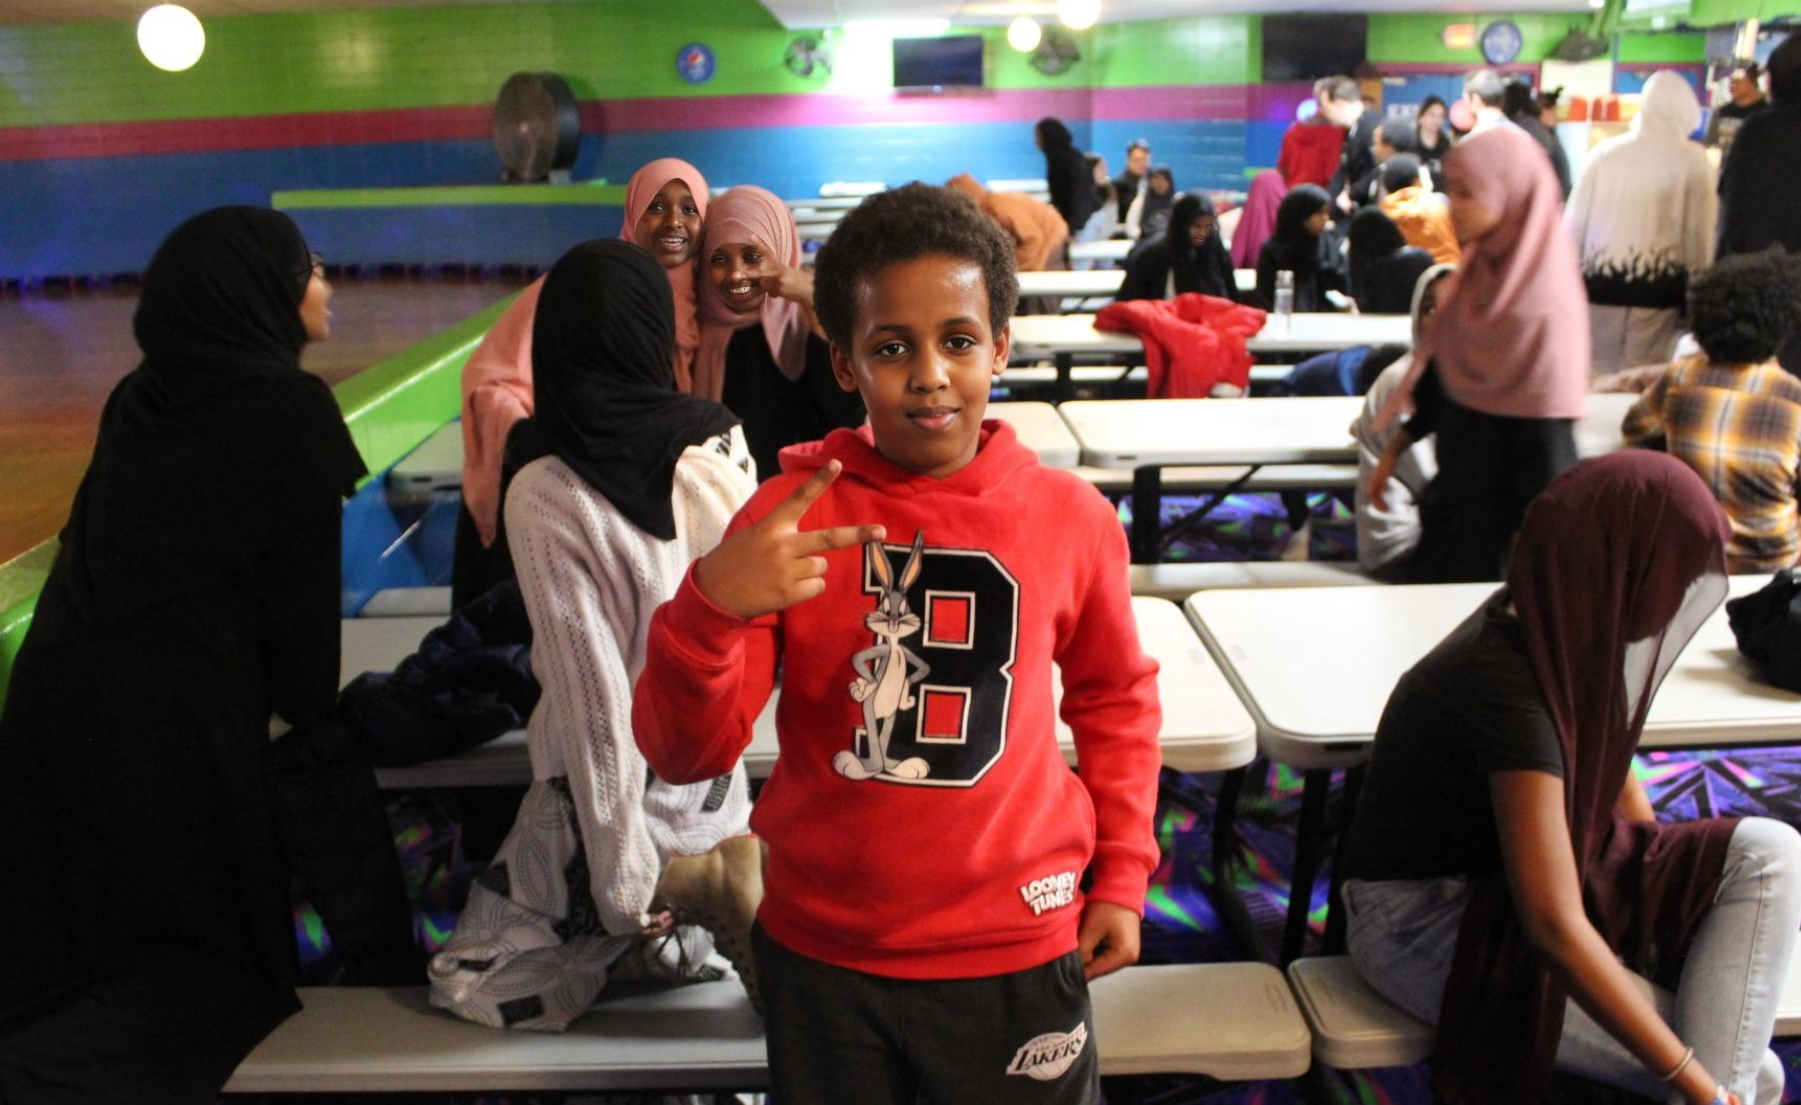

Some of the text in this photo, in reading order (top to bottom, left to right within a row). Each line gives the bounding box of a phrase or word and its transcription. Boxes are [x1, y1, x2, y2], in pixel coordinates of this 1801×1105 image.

[855, 542, 1020, 788] B
[1020, 871, 1076, 903] LOONEY
[1029, 890, 1074, 916] TUNES
[1011, 1034, 1084, 1072] LAKERS
